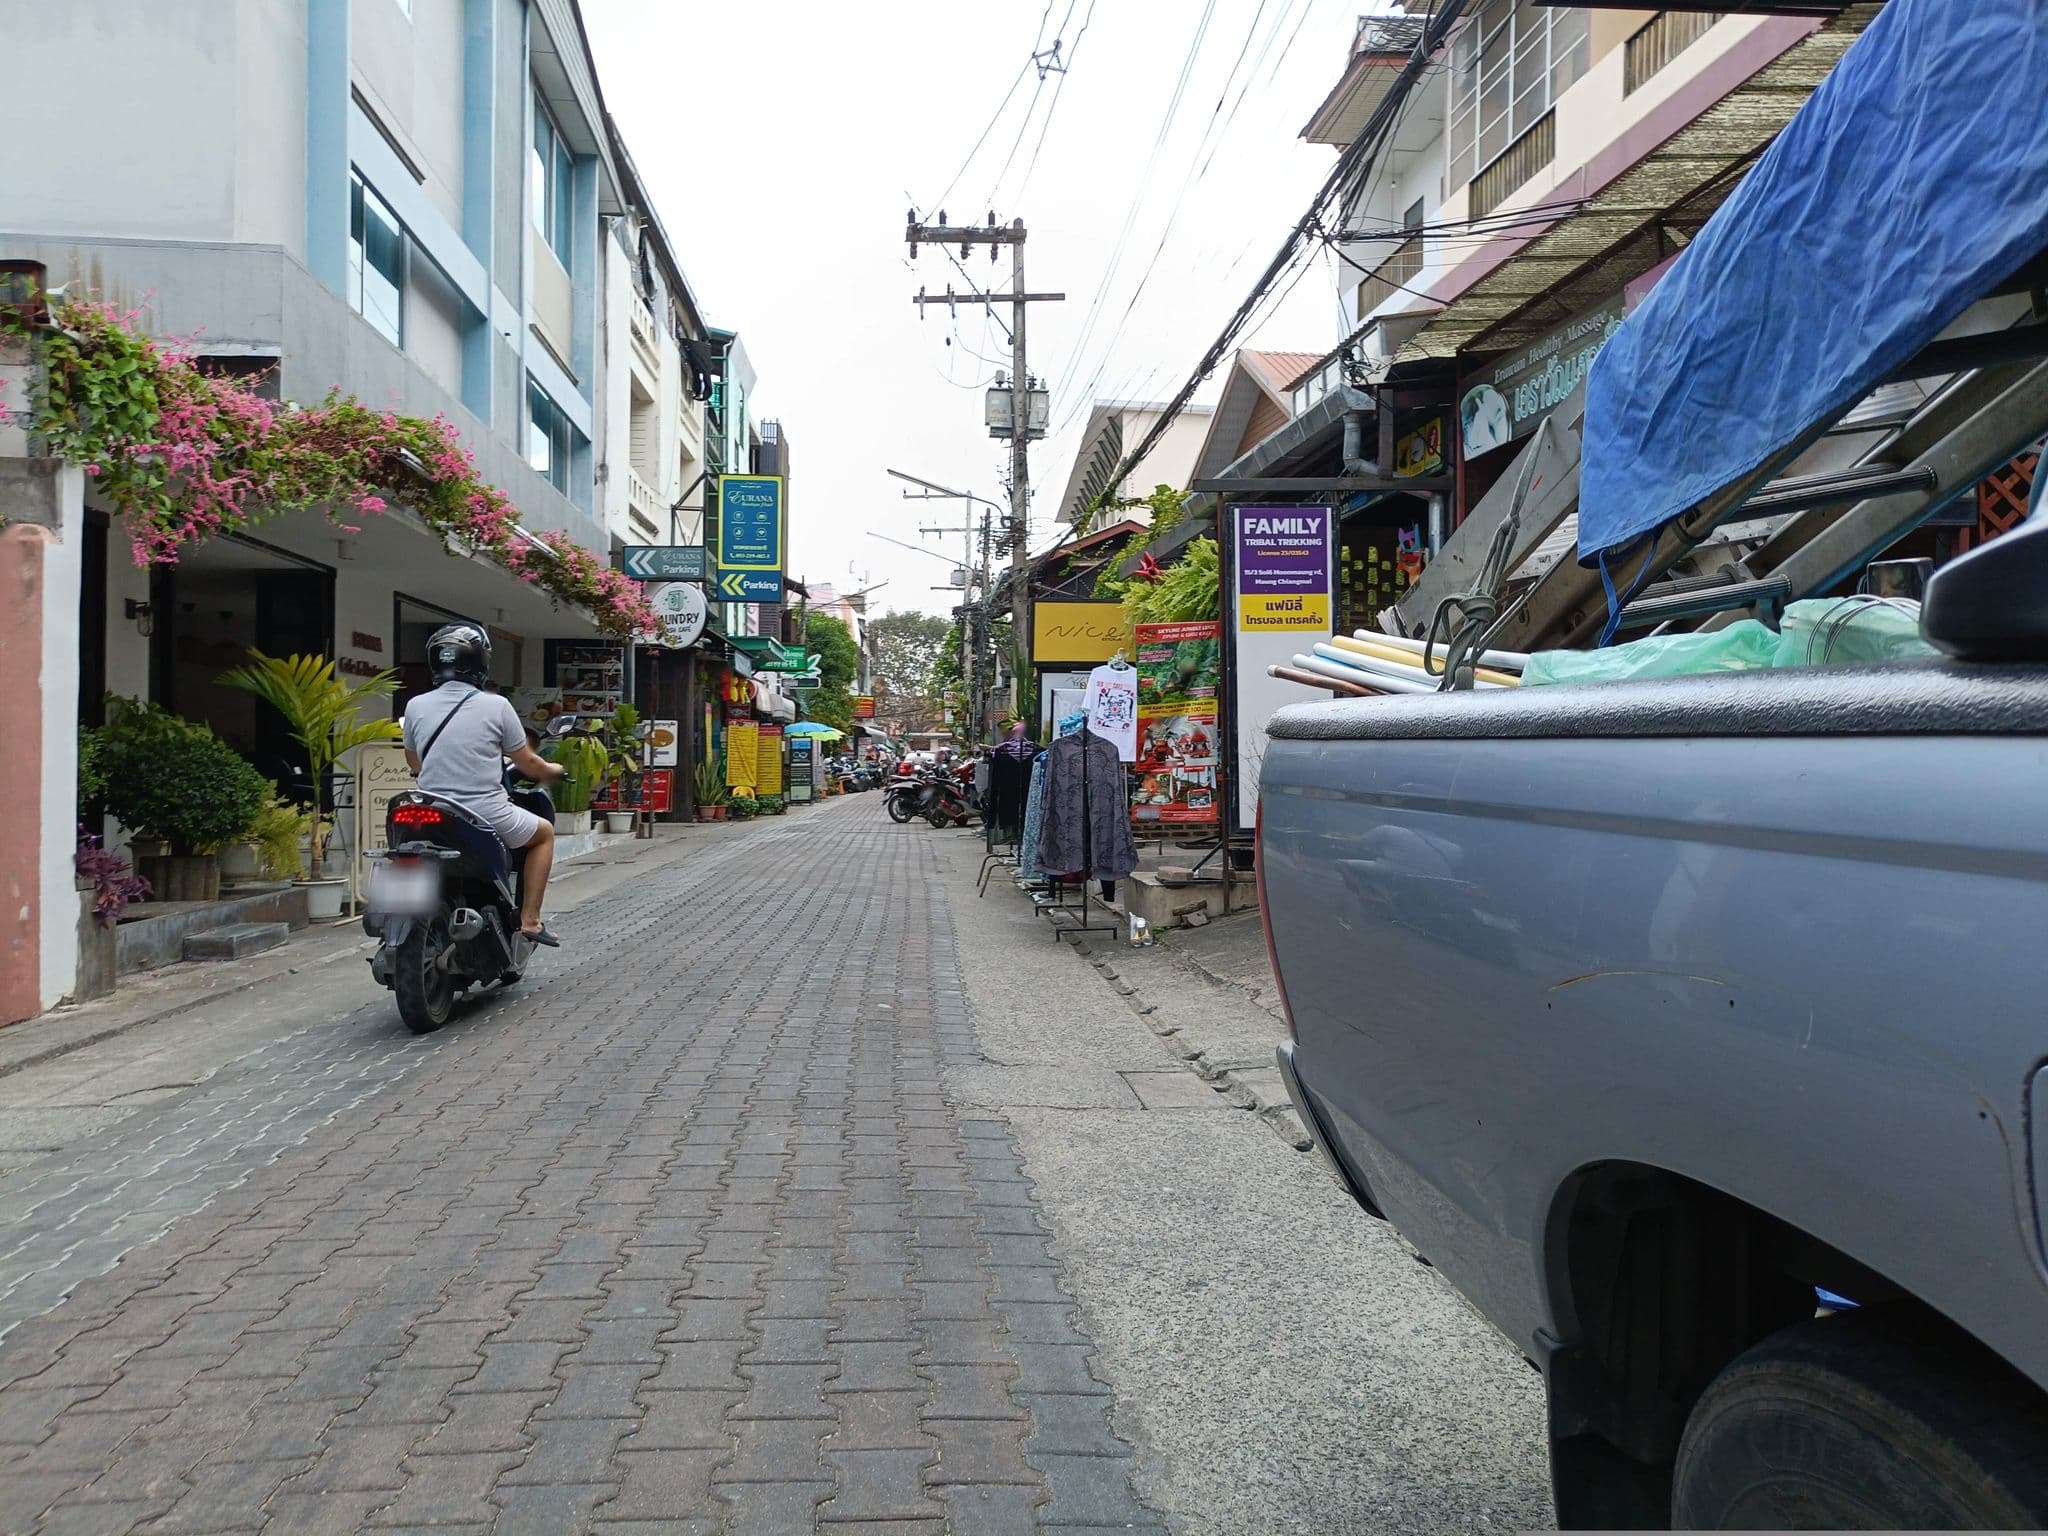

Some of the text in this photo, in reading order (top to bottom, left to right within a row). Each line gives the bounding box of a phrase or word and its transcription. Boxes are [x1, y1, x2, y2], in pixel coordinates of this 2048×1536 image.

[1529, 336, 1562, 365] Healthy
[1567, 311, 1607, 341] Massage
[1244, 518, 1321, 534] FAMILY
[663, 565, 699, 576] Parking
[743, 580, 778, 591] Parking
[1266, 595, 1303, 611] แฟมิลี่
